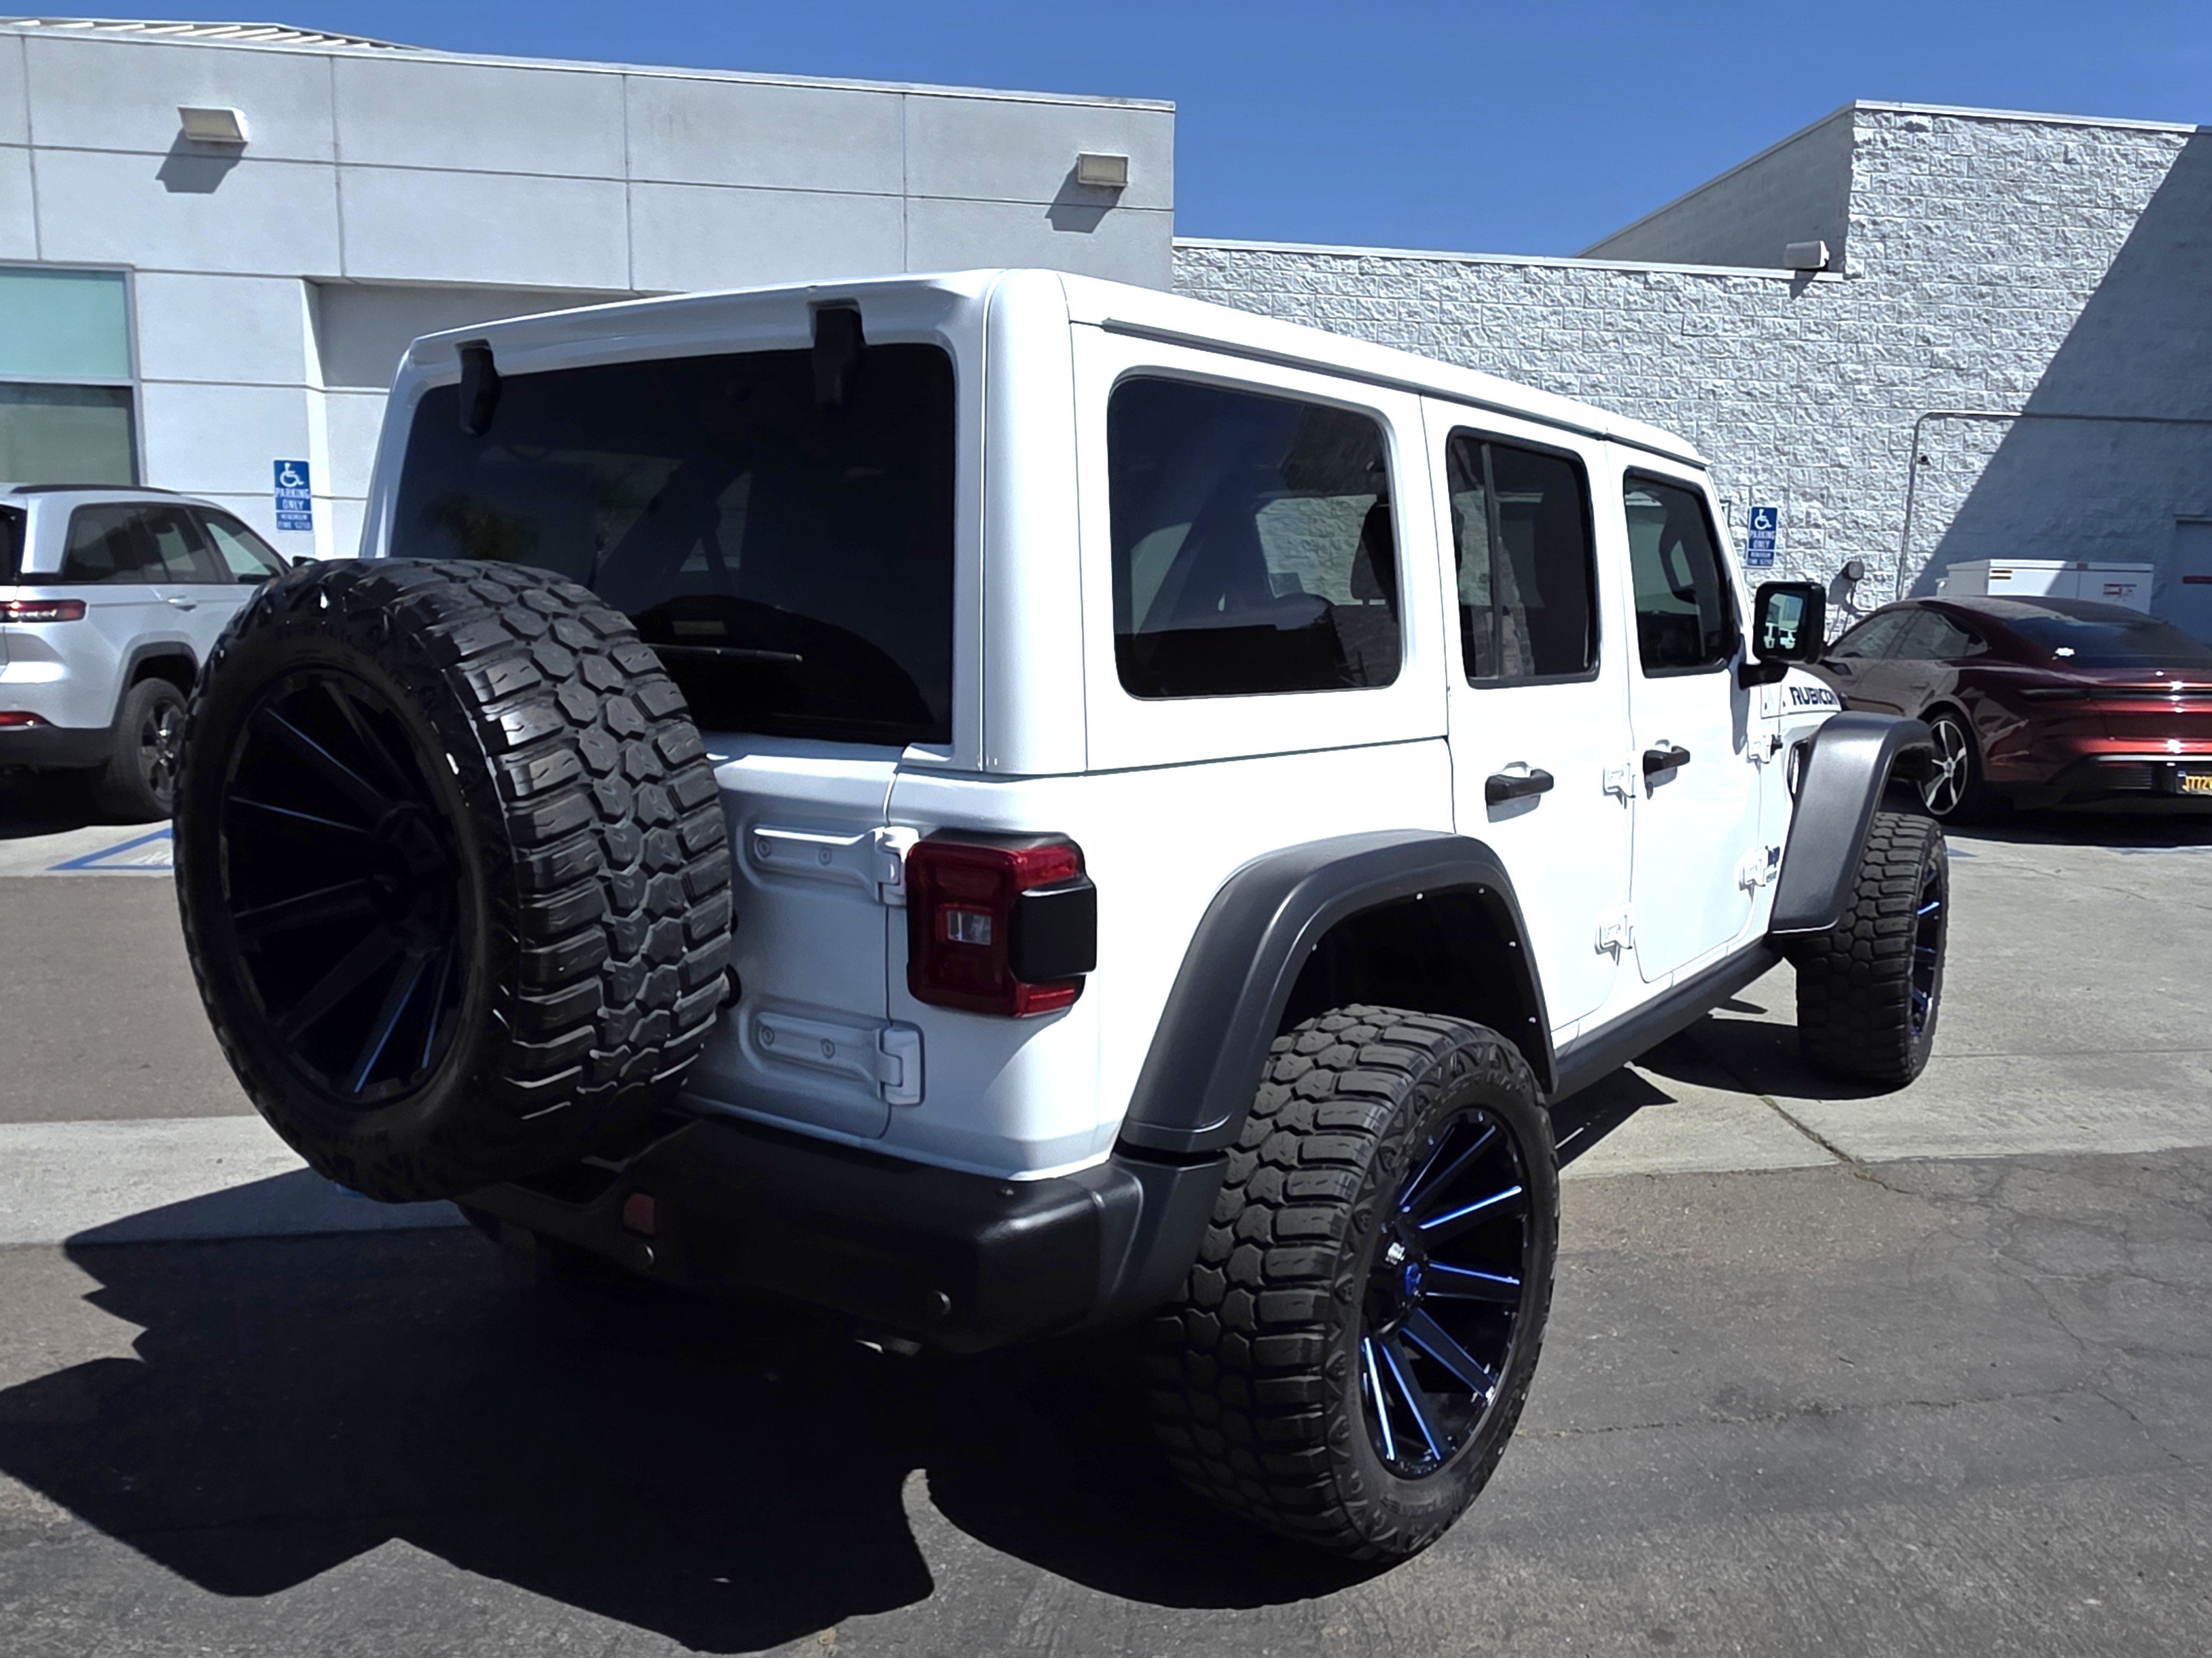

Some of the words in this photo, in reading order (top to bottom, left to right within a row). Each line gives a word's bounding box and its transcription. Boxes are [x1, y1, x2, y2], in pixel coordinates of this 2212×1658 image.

[274, 487, 311, 499] PARKING
[282, 498, 304, 510] ONLY
[1748, 530, 1775, 540] PARKING
[1753, 540, 1771, 549] ONLY
